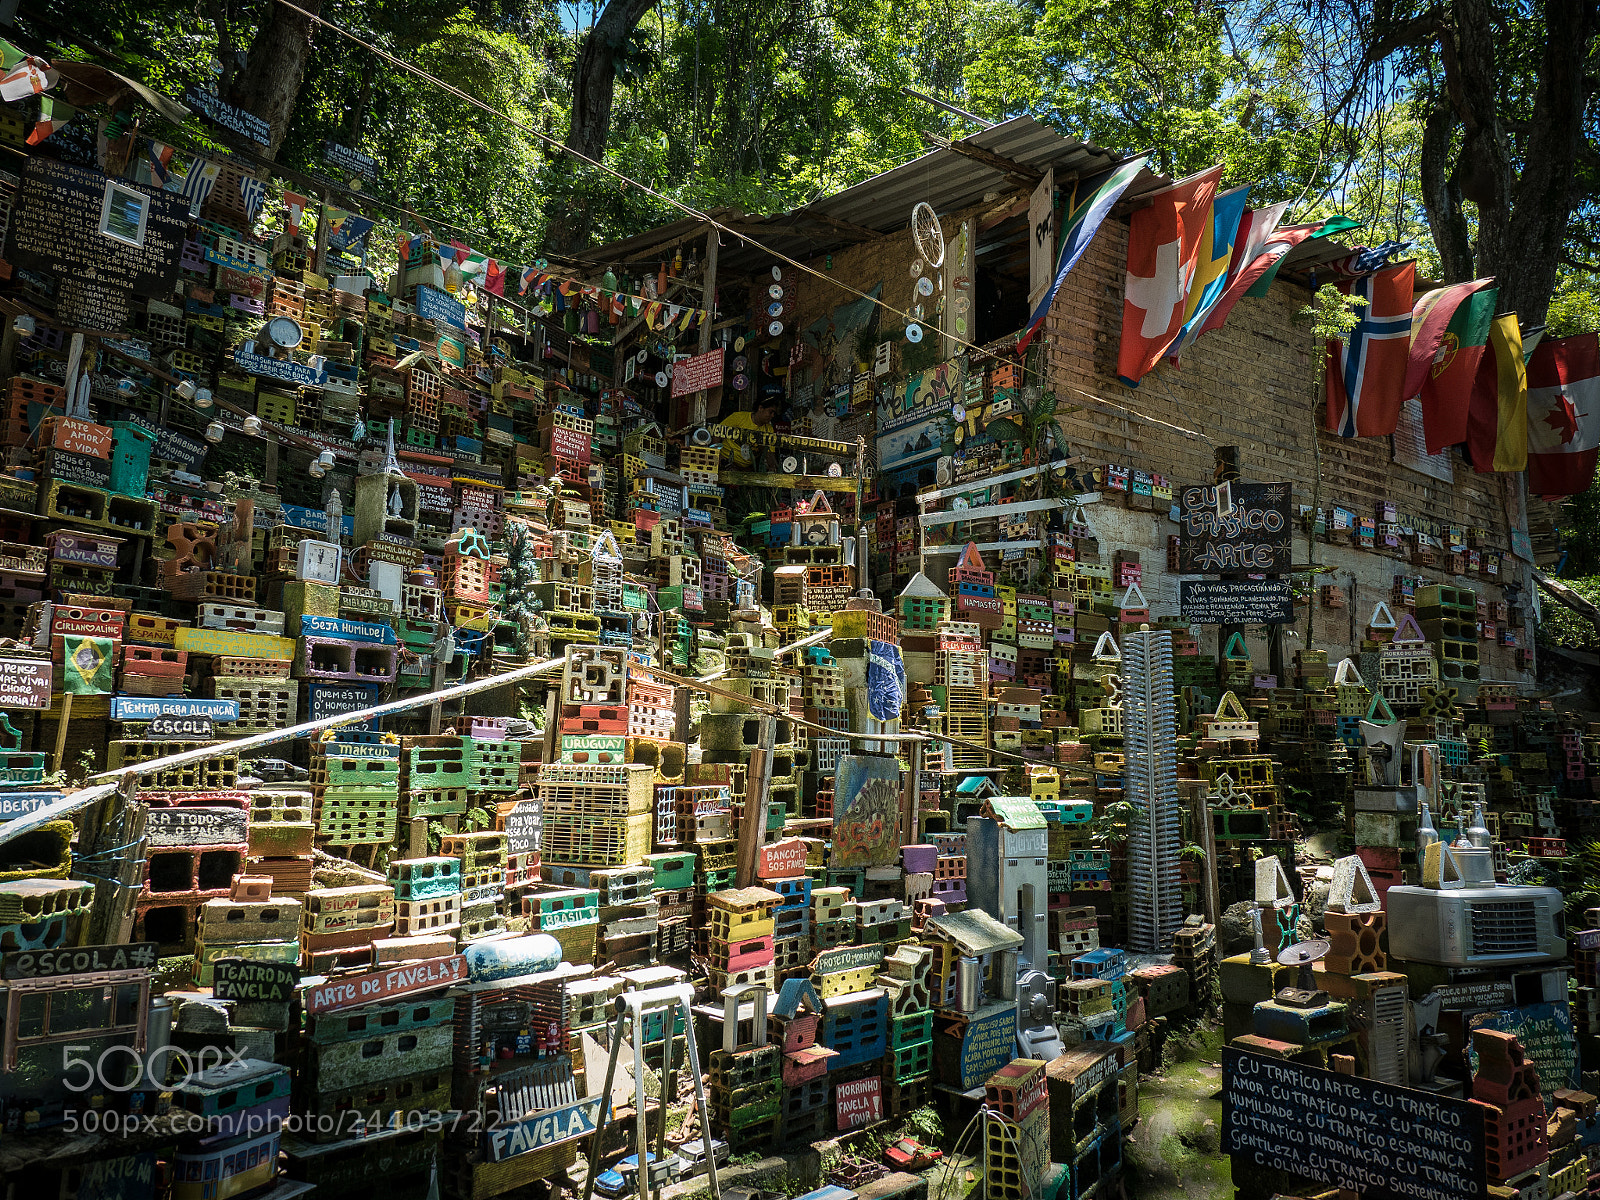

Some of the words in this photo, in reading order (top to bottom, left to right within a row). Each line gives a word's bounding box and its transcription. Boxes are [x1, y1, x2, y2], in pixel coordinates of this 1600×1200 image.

[24, 177, 54, 191] TODOS
[22, 195, 45, 208] TUDO
[62, 418, 89, 432] ARTE
[75, 441, 100, 457] VIDA
[1181, 508, 1287, 538] TRAFICO
[59, 549, 99, 563] LAYLA
[1194, 541, 1277, 570] ARTE
[52, 578, 93, 591] LUANA
[54, 619, 86, 632] CIRLAN
[96, 623, 120, 635] ALINE
[310, 618, 339, 633] SEJA
[341, 620, 386, 644] HUMILDE!
[1, 684, 33, 695] CHORE
[316, 689, 340, 702] QUEM
[354, 690, 367, 701] TU
[0, 695, 38, 707] ORRIA!!
[119, 701, 161, 715] TENTAR
[325, 701, 356, 711] HOMEM
[152, 719, 212, 734] ESCOLA
[564, 739, 623, 750] URUGUAY
[177, 812, 223, 826] TODOS
[766, 848, 796, 861] BANCO
[324, 899, 358, 911] SILAN
[545, 909, 583, 926] BRASIL
[217, 963, 275, 982] TEATRO
[277, 969, 295, 986] DA
[216, 981, 282, 999] FAVELA
[313, 982, 357, 1009] ARTE
[361, 978, 382, 996] DE
[838, 1080, 879, 1098] MORRINHO
[1262, 1062, 1321, 1090] TRAFICO
[1372, 1088, 1394, 1108] EU
[1397, 1095, 1461, 1126] TRAFICO
[838, 1098, 870, 1114] FAVELA
[848, 1111, 872, 1126] TOUR
[1271, 1083, 1292, 1102] EU
[1291, 1089, 1346, 1116] TRAFICO
[1390, 1116, 1410, 1134] EU
[1412, 1122, 1472, 1152] TRAFICO
[491, 1110, 585, 1164] FAVELA
[1305, 1111, 1325, 1128] EU
[1326, 1118, 1386, 1148] TRAFICO
[1231, 1109, 1248, 1126] EU
[1248, 1116, 1305, 1144] TRAFICO
[1396, 1155, 1417, 1176] EU
[1420, 1164, 1478, 1193] TRAFICO
[1273, 1156, 1331, 1183] OLIVEIRA
[1308, 1152, 1328, 1169] EU
[1328, 1158, 1386, 1187] TRAFICO
